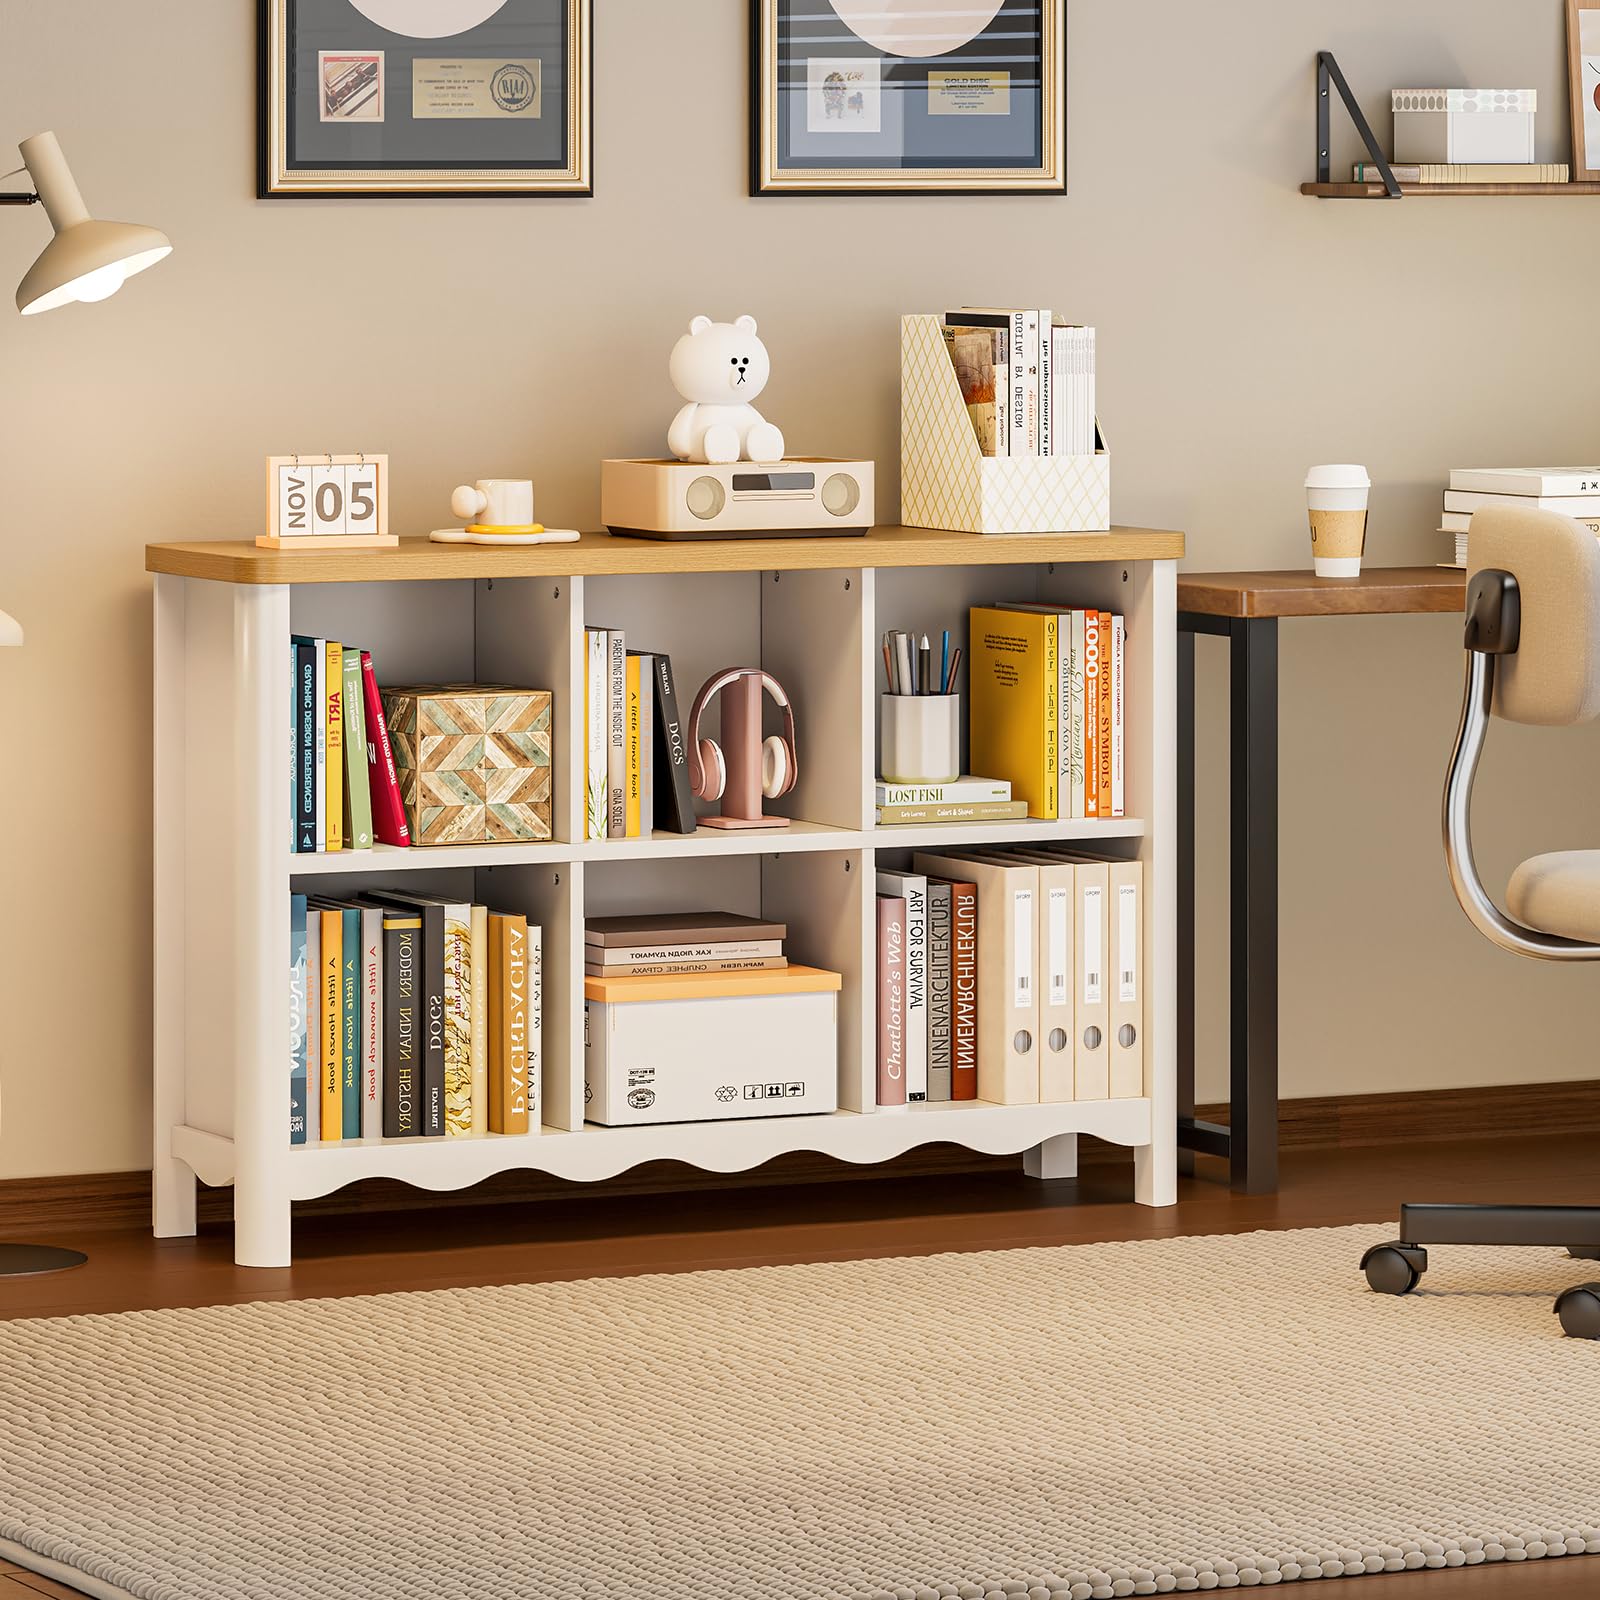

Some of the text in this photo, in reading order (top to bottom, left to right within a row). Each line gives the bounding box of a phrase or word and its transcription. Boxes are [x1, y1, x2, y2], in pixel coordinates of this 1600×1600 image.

[288, 476, 306, 528] NOV
[1086, 617, 1099, 678] 1000
[612, 639, 622, 747] PARENTING FROM THE INSIDE OUT
[631, 692, 637, 701] A
[1101, 661, 1109, 702] BOOK
[1061, 658, 1071, 776] Yo voy conmigo
[668, 722, 684, 765] DOGS
[1101, 717, 1110, 789] SYMBOLS
[612, 788, 622, 828] GINA SOLEIL
[889, 788, 943, 803] LOST FISH
[888, 922, 901, 965] Web
[910, 890, 923, 1010] ART FOR SURVIVAL
[932, 897, 949, 1069] INNENARCHITEKTUR
